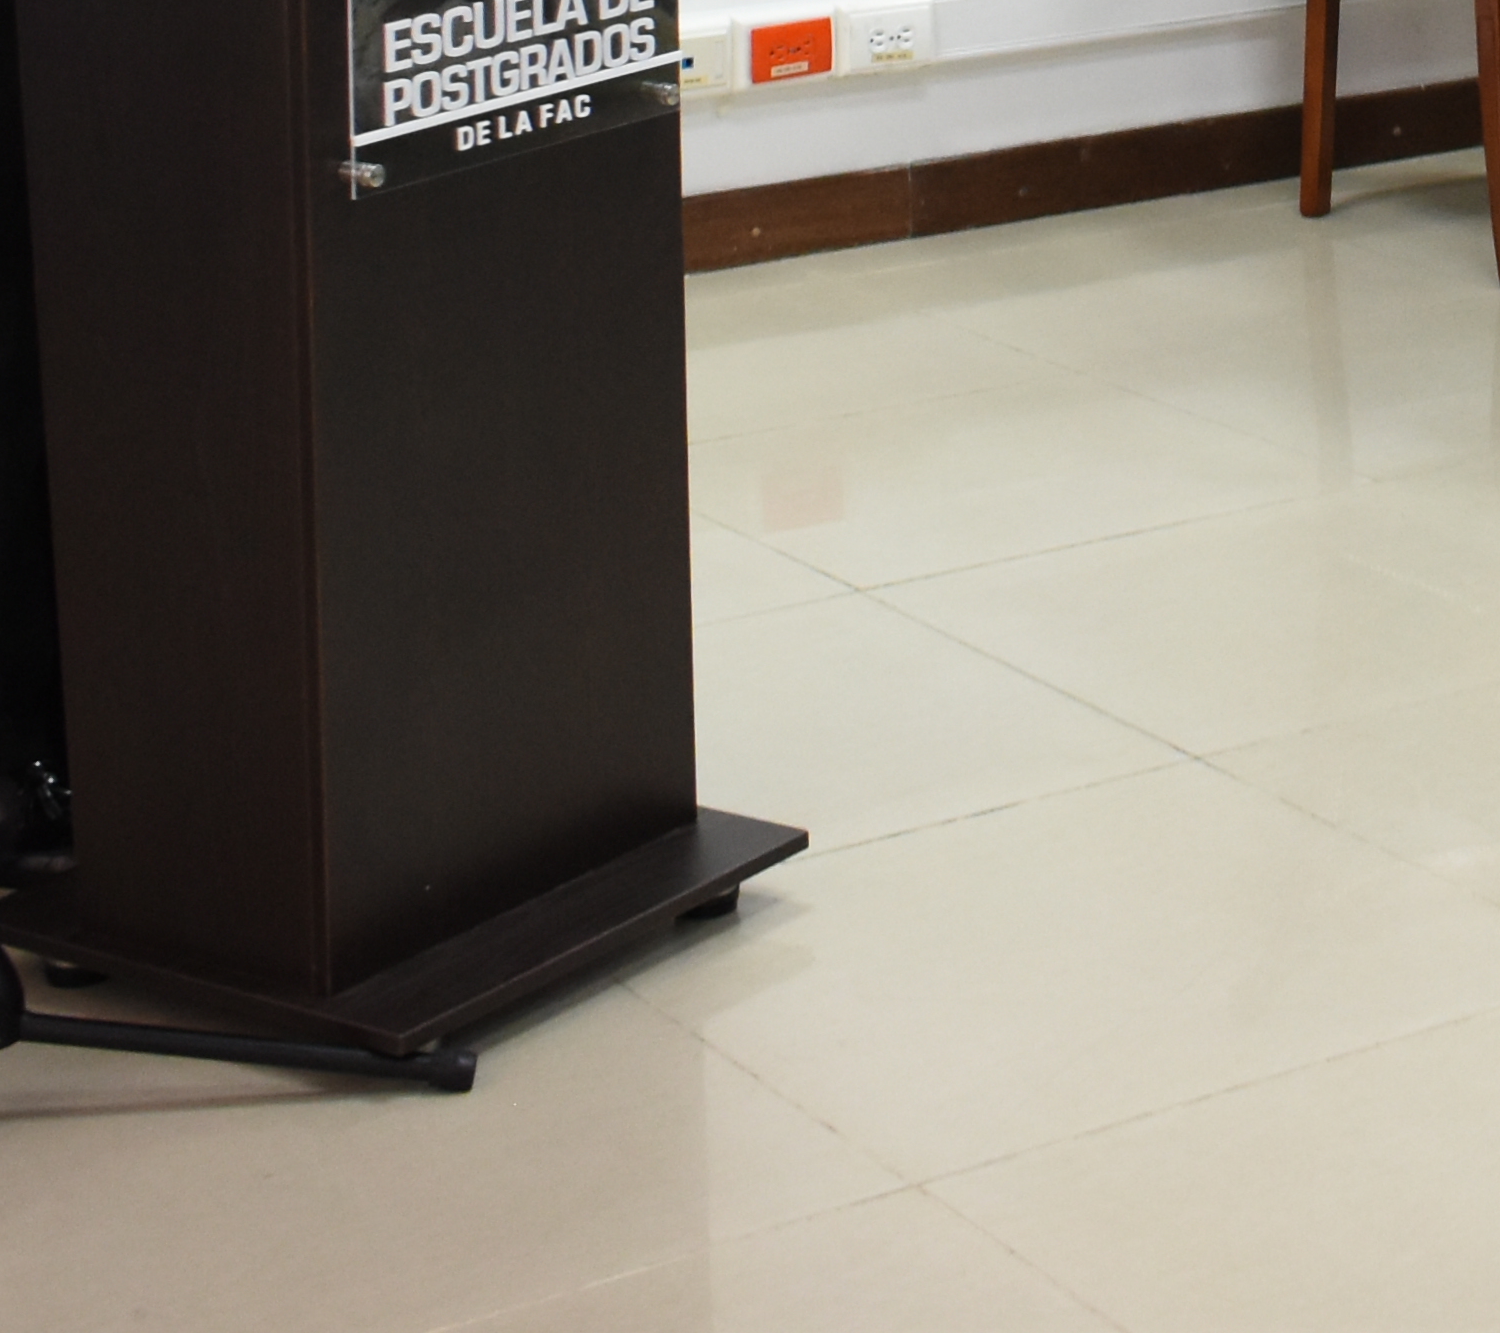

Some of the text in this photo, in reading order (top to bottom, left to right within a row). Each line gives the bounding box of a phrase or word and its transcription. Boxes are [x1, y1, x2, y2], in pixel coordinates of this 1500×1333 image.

[383, 16, 656, 127] POSTGRADOS
[456, 93, 592, 152] DE LA FAC
